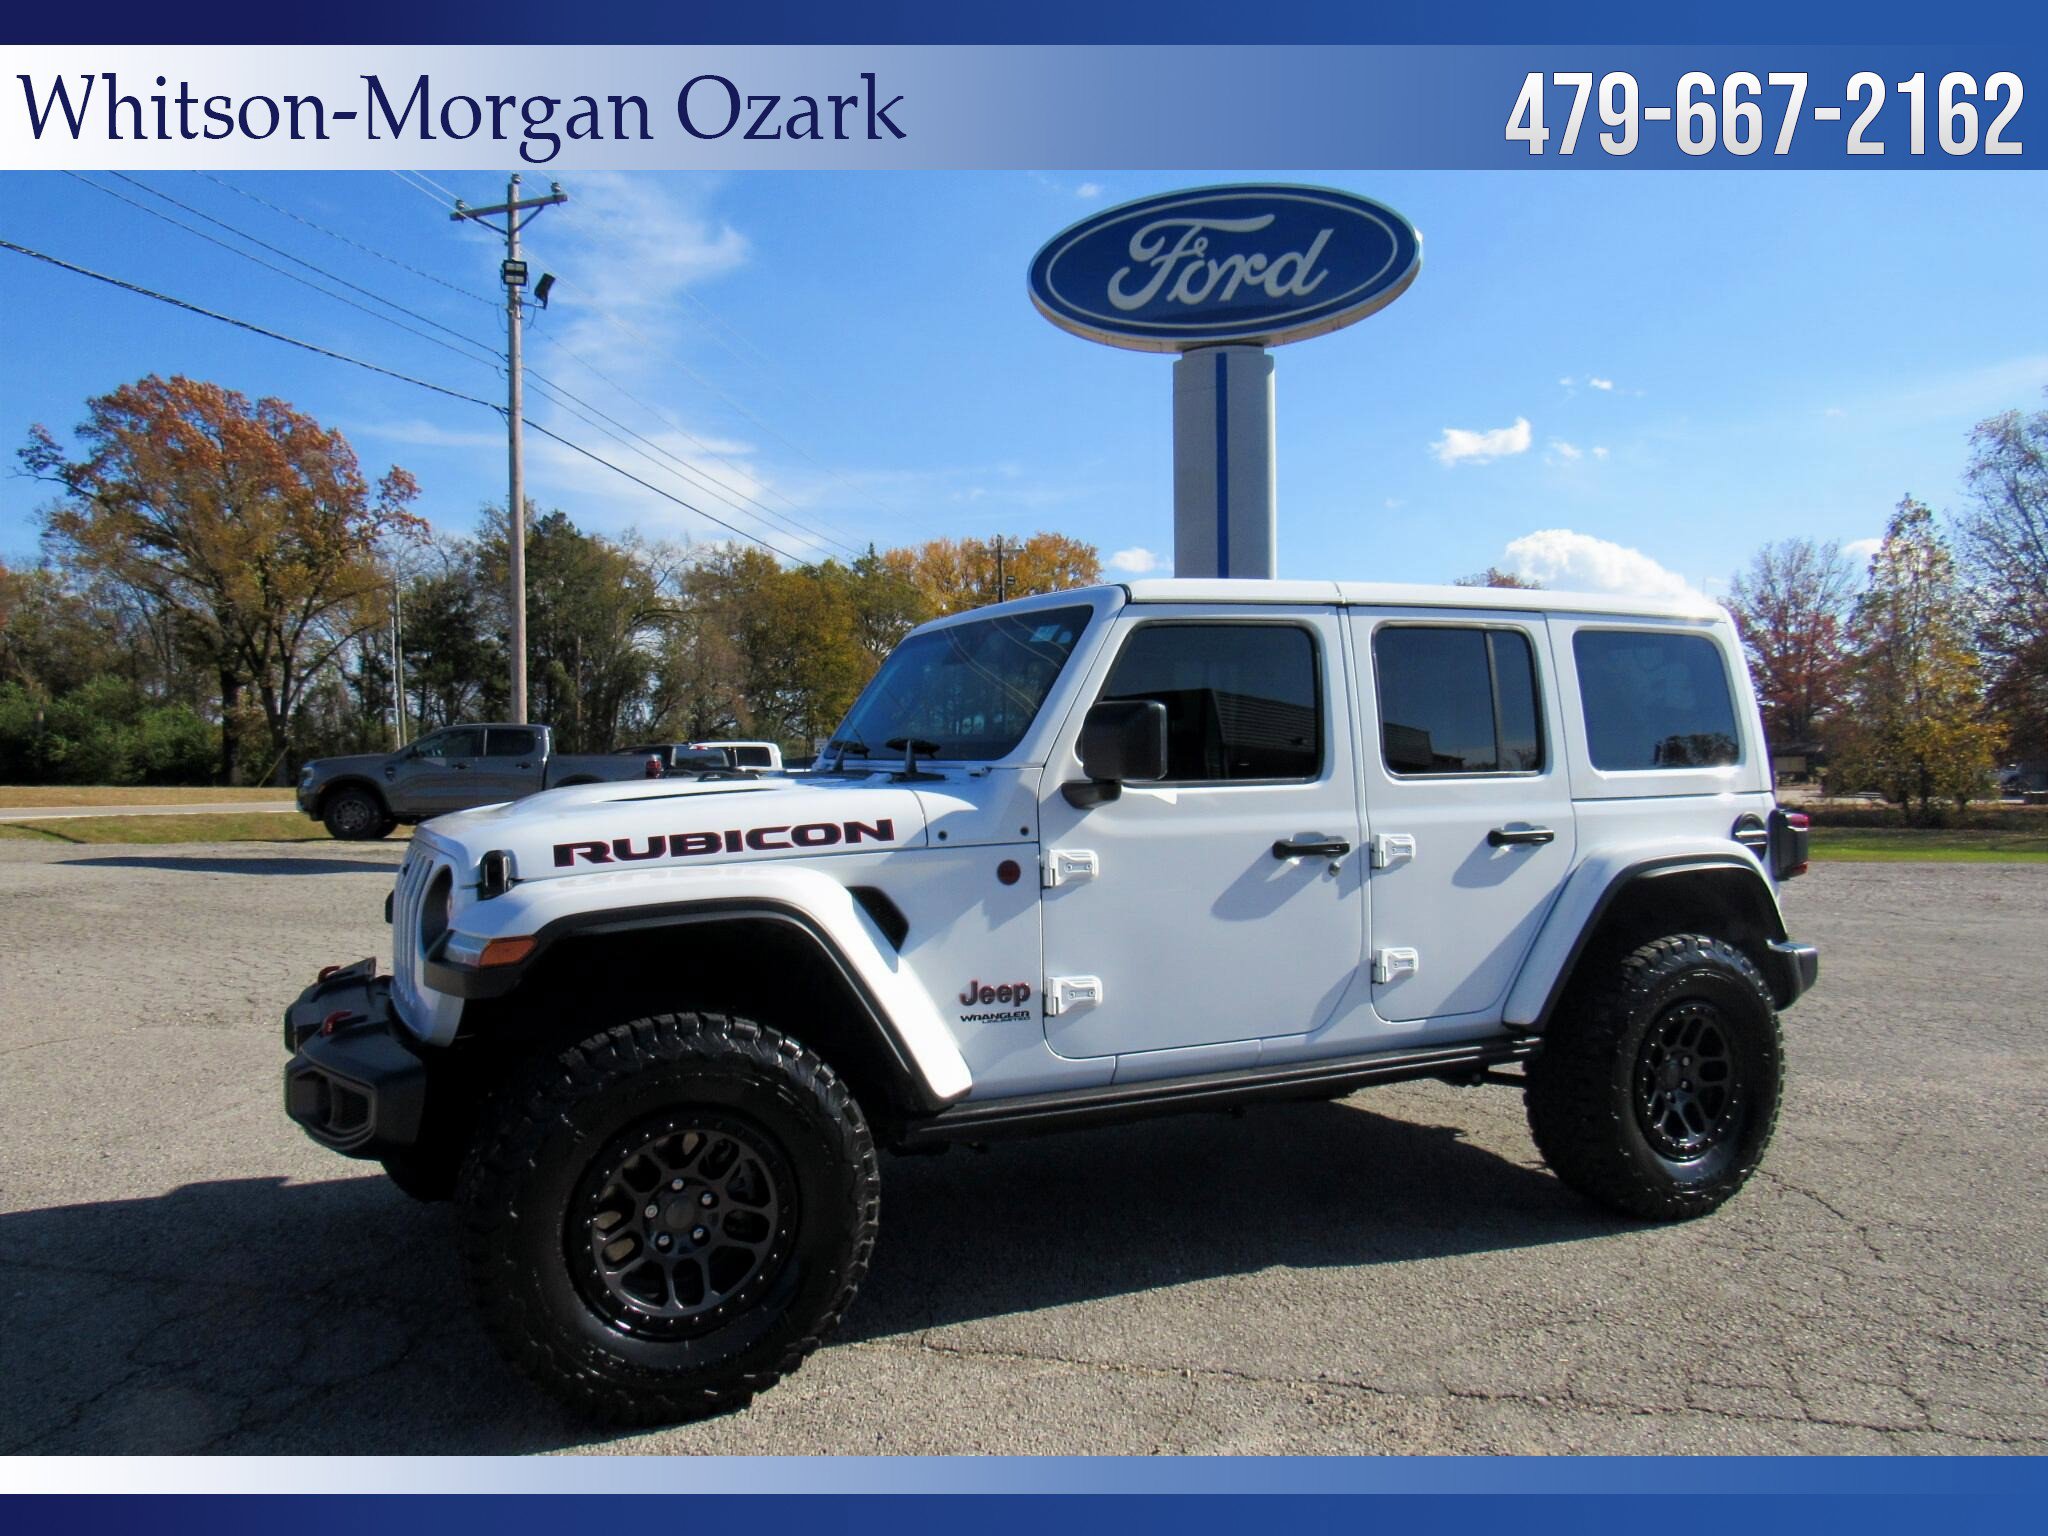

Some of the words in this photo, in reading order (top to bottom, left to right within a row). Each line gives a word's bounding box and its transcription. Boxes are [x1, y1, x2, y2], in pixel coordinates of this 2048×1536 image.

[1107, 213, 1334, 311] Ford
[552, 818, 895, 868] RUBICON
[959, 979, 1031, 1007] Jeep
[960, 1010, 1030, 1022] WRANGLER
